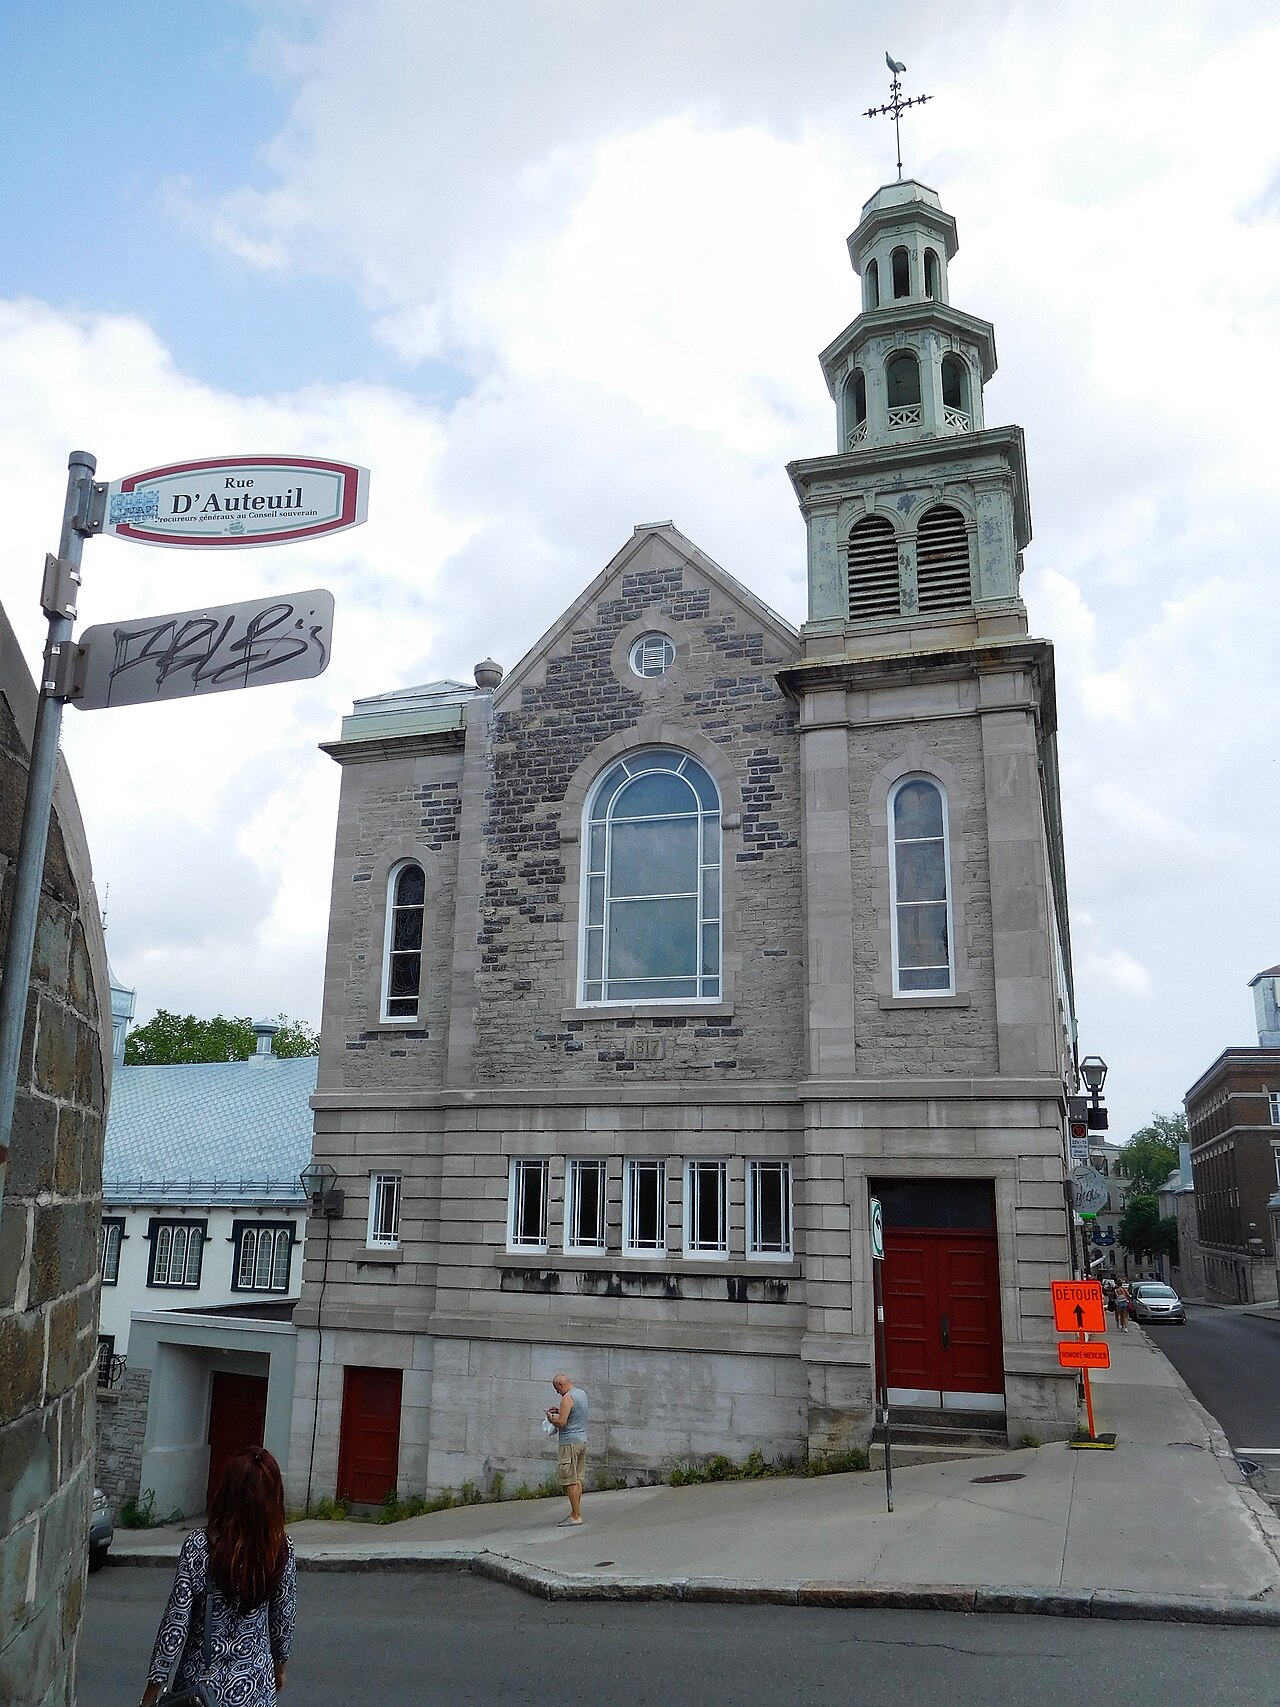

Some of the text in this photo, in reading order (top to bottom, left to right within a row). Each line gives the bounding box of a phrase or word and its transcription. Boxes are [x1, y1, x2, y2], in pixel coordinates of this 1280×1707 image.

[225, 477, 254, 489] Rue
[171, 487, 303, 514] D’Auteuil
[199, 513, 235, 522] généraux
[248, 510, 277, 519] Conseil
[279, 509, 318, 517] souverain
[1055, 1285, 1099, 1301] DÉTOUR
[1061, 1350, 1108, 1360] HONORÉ-MERCIER
